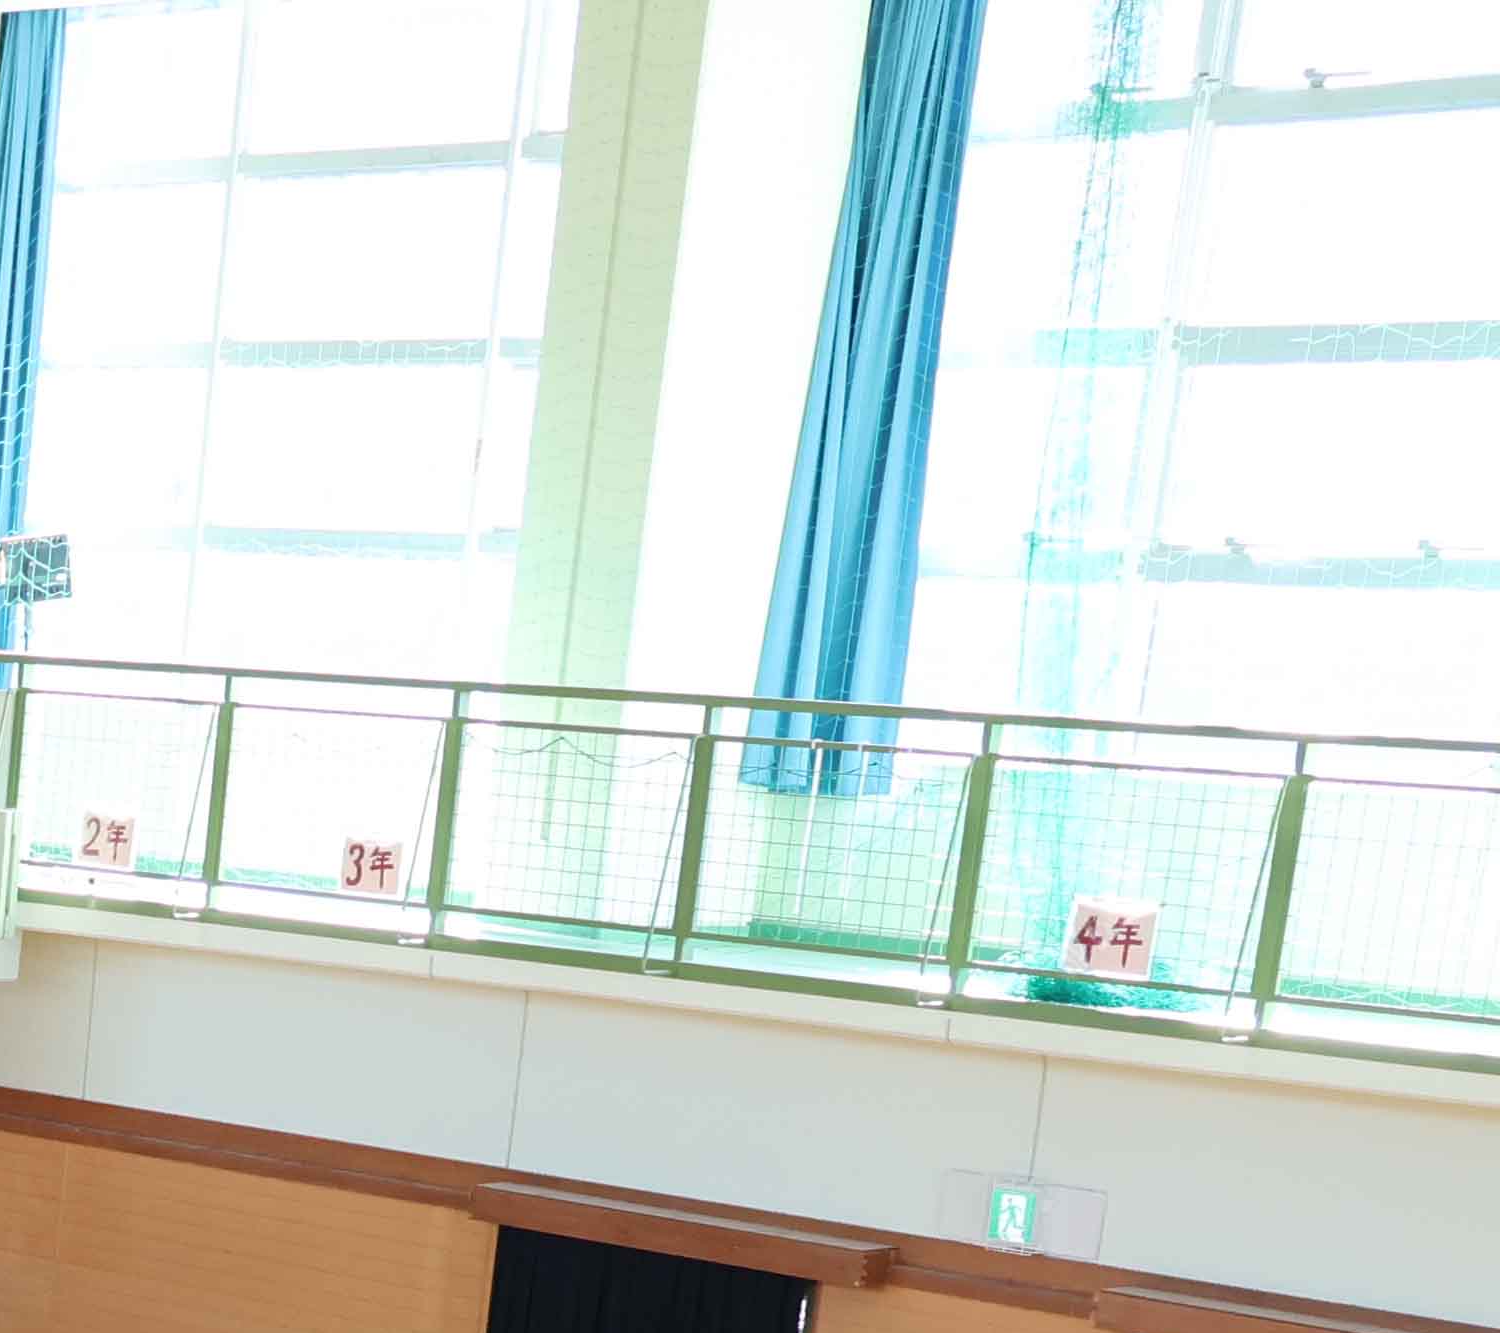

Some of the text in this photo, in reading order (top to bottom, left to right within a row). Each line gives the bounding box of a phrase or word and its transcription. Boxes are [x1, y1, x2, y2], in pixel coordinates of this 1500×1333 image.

[82, 815, 129, 862] 2年
[345, 842, 395, 890] 3年
[1073, 915, 1143, 969] 4年
